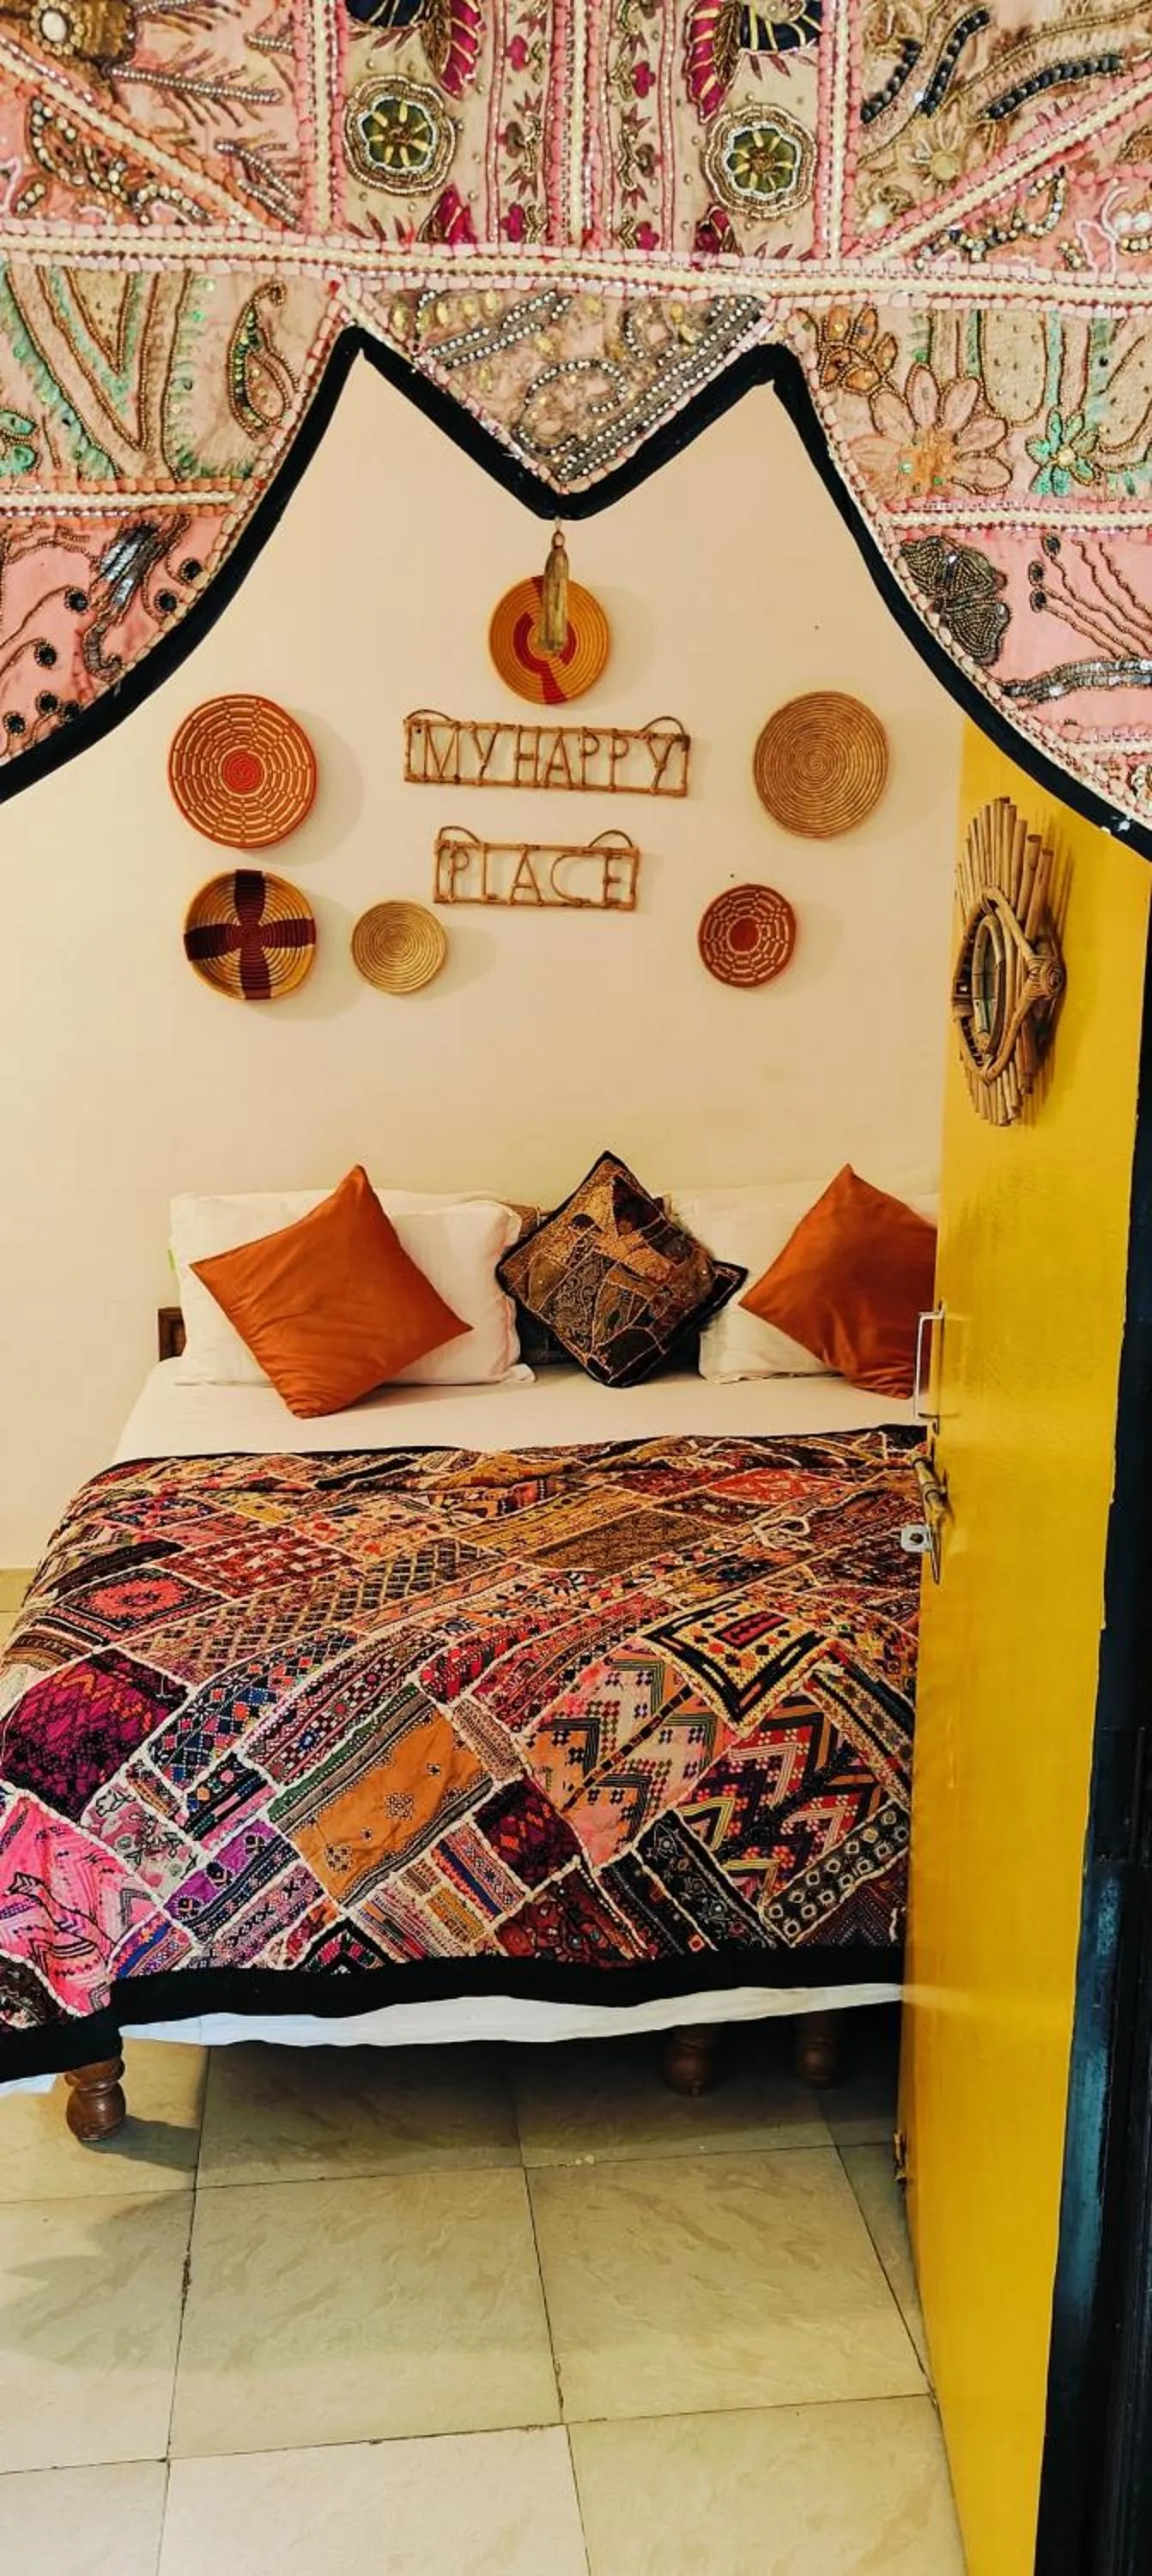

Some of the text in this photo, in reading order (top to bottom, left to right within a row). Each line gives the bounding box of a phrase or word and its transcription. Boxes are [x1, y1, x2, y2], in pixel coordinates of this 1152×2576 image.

[423, 720, 676, 795] MY HAPPY
[447, 842, 623, 908] PLACE
